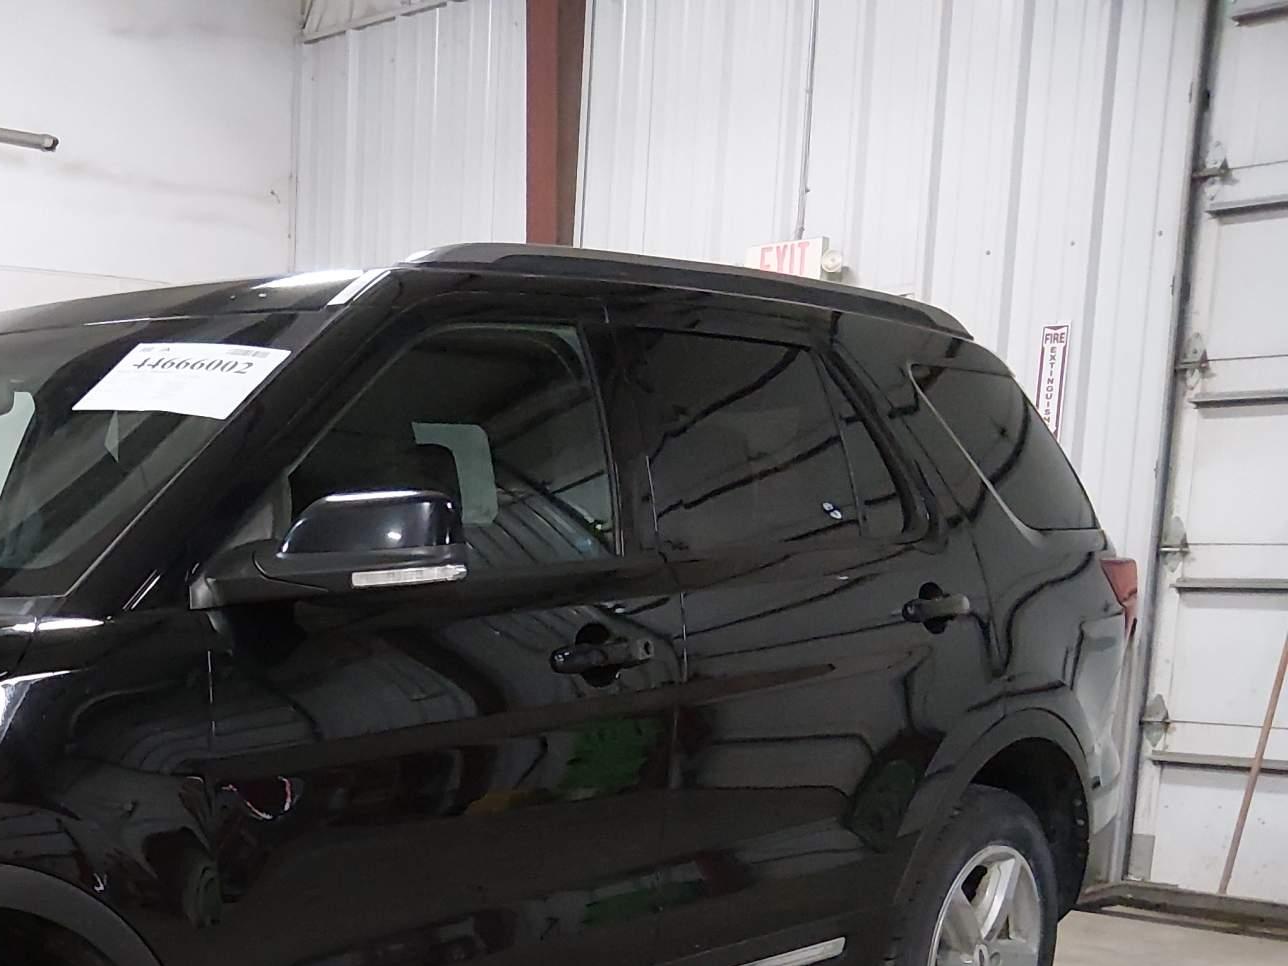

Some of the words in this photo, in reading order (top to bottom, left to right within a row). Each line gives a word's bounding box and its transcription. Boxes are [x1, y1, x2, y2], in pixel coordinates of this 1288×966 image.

[759, 241, 810, 275] EXIT
[1044, 332, 1066, 344] FIRE
[132, 357, 254, 374] 44666002
